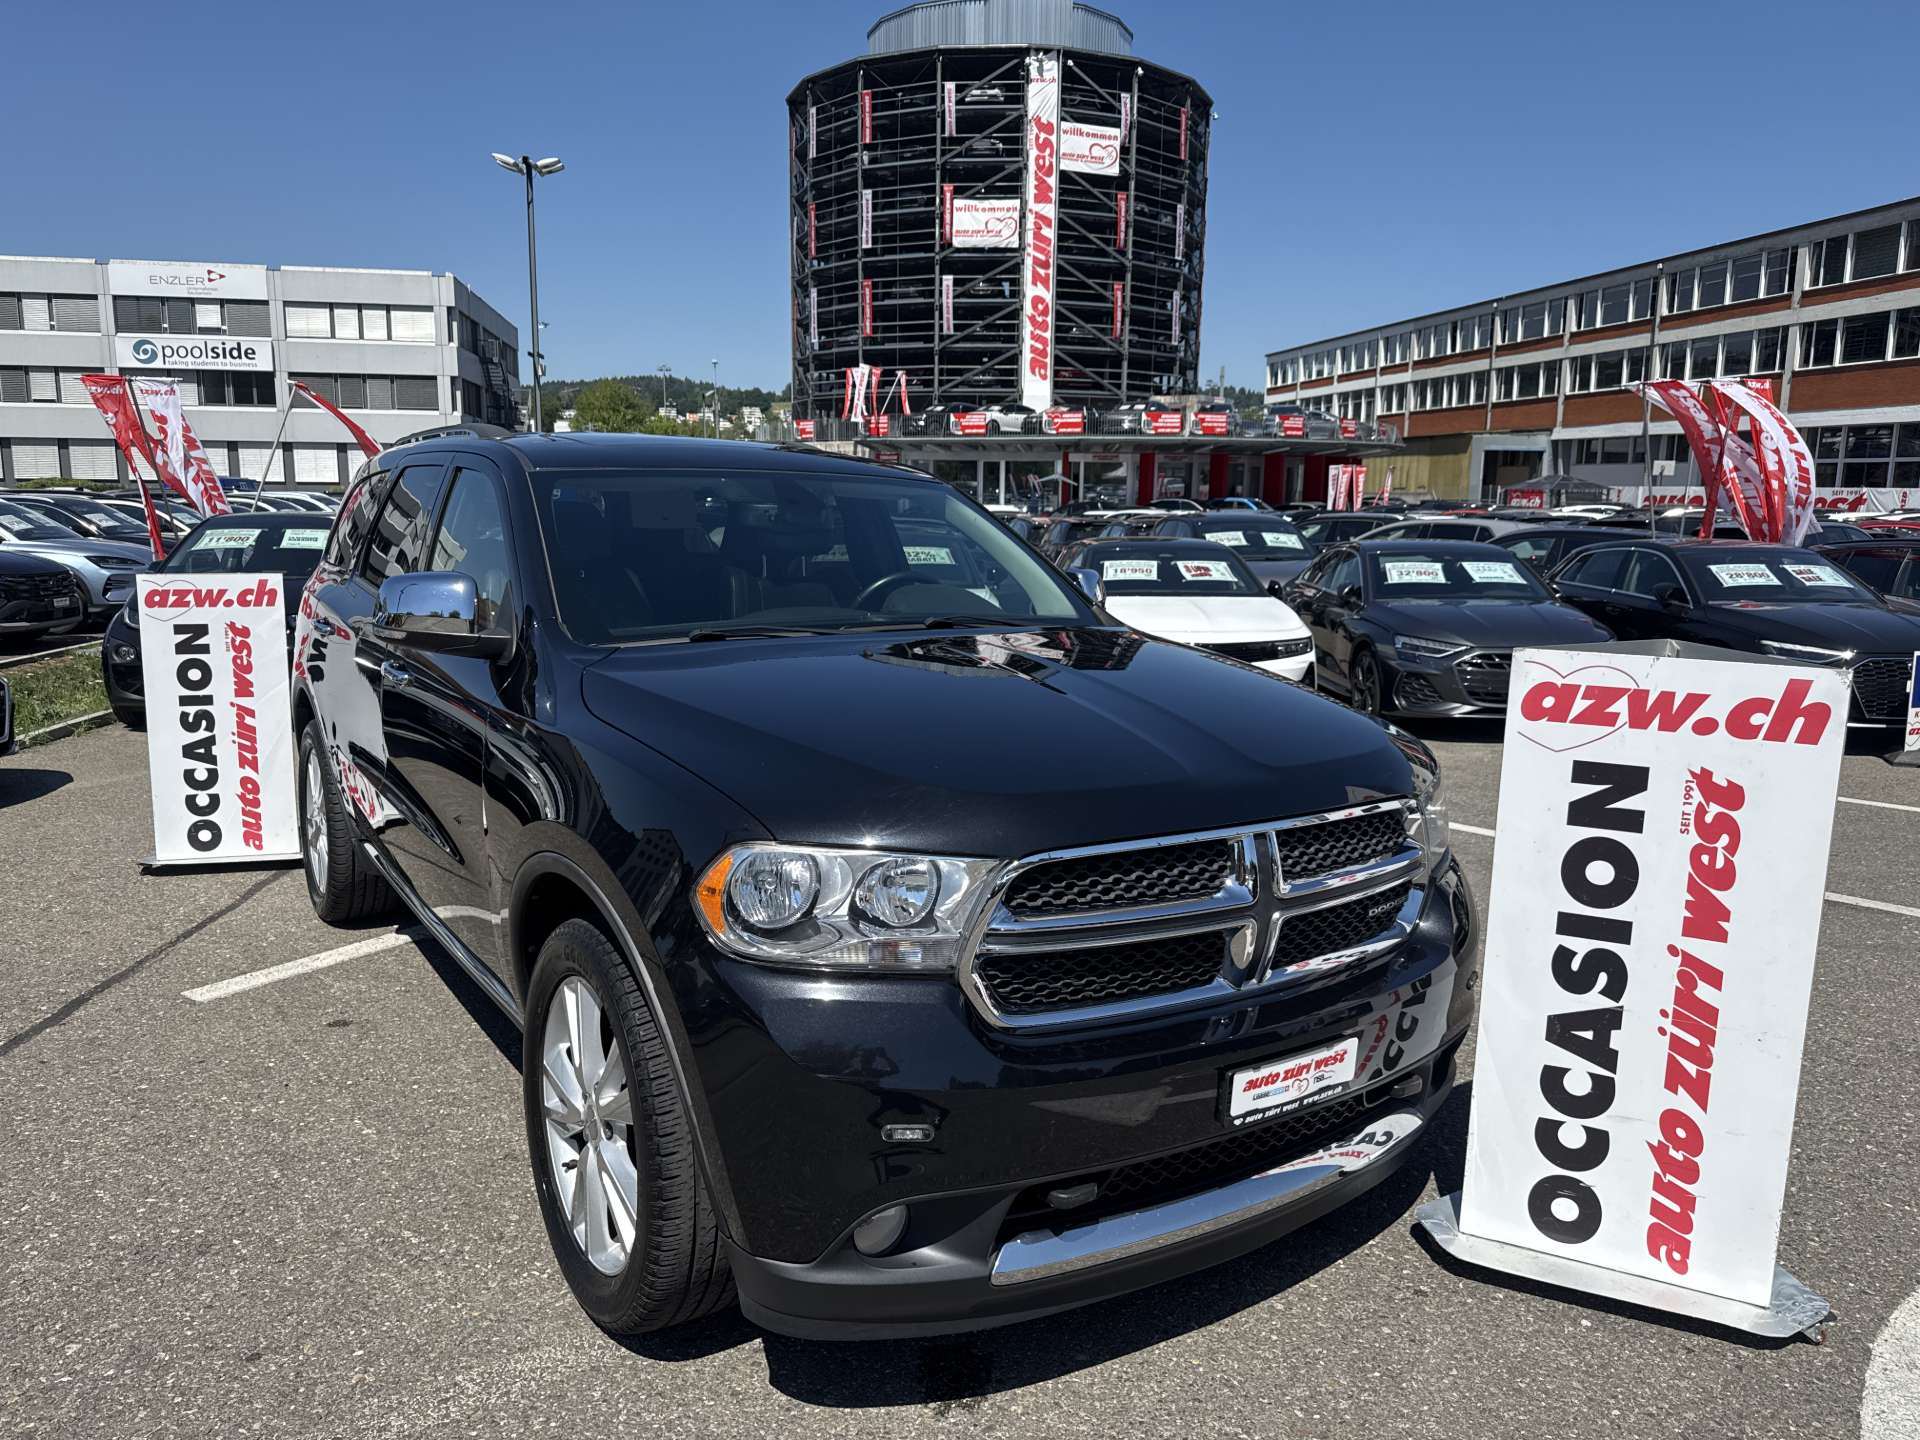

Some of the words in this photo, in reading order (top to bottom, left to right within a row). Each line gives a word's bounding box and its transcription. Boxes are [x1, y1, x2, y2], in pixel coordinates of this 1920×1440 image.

[1032, 115, 1054, 204] west
[1062, 127, 1119, 141] willkommen
[955, 204, 1018, 213] willkommen
[149, 274, 206, 286] ENZLER
[1027, 208, 1052, 293] züri
[161, 340, 257, 365] poolside
[167, 360, 189, 368] taking
[190, 360, 220, 368] students
[1028, 295, 1050, 381] auto
[144, 578, 278, 609] azw.ch
[1726, 571, 1771, 579] 28'800
[224, 620, 254, 698] west
[172, 623, 223, 853] OCCASION
[229, 701, 259, 776] züri
[1520, 678, 1832, 746] azw.ch
[235, 775, 264, 851] auto
[1679, 810, 1692, 835] SEIT
[1682, 779, 1695, 806] 1991
[1681, 766, 1746, 944] west
[1527, 760, 1651, 1244] OCCASION
[1658, 943, 1724, 1114] züri
[1242, 1071, 1281, 1093] auto
[1281, 1060, 1313, 1082] züri
[1313, 1048, 1348, 1071] west
[1244, 1112, 1263, 1123] auto
[1282, 1101, 1300, 1113] west
[1645, 1108, 1705, 1276] auto
